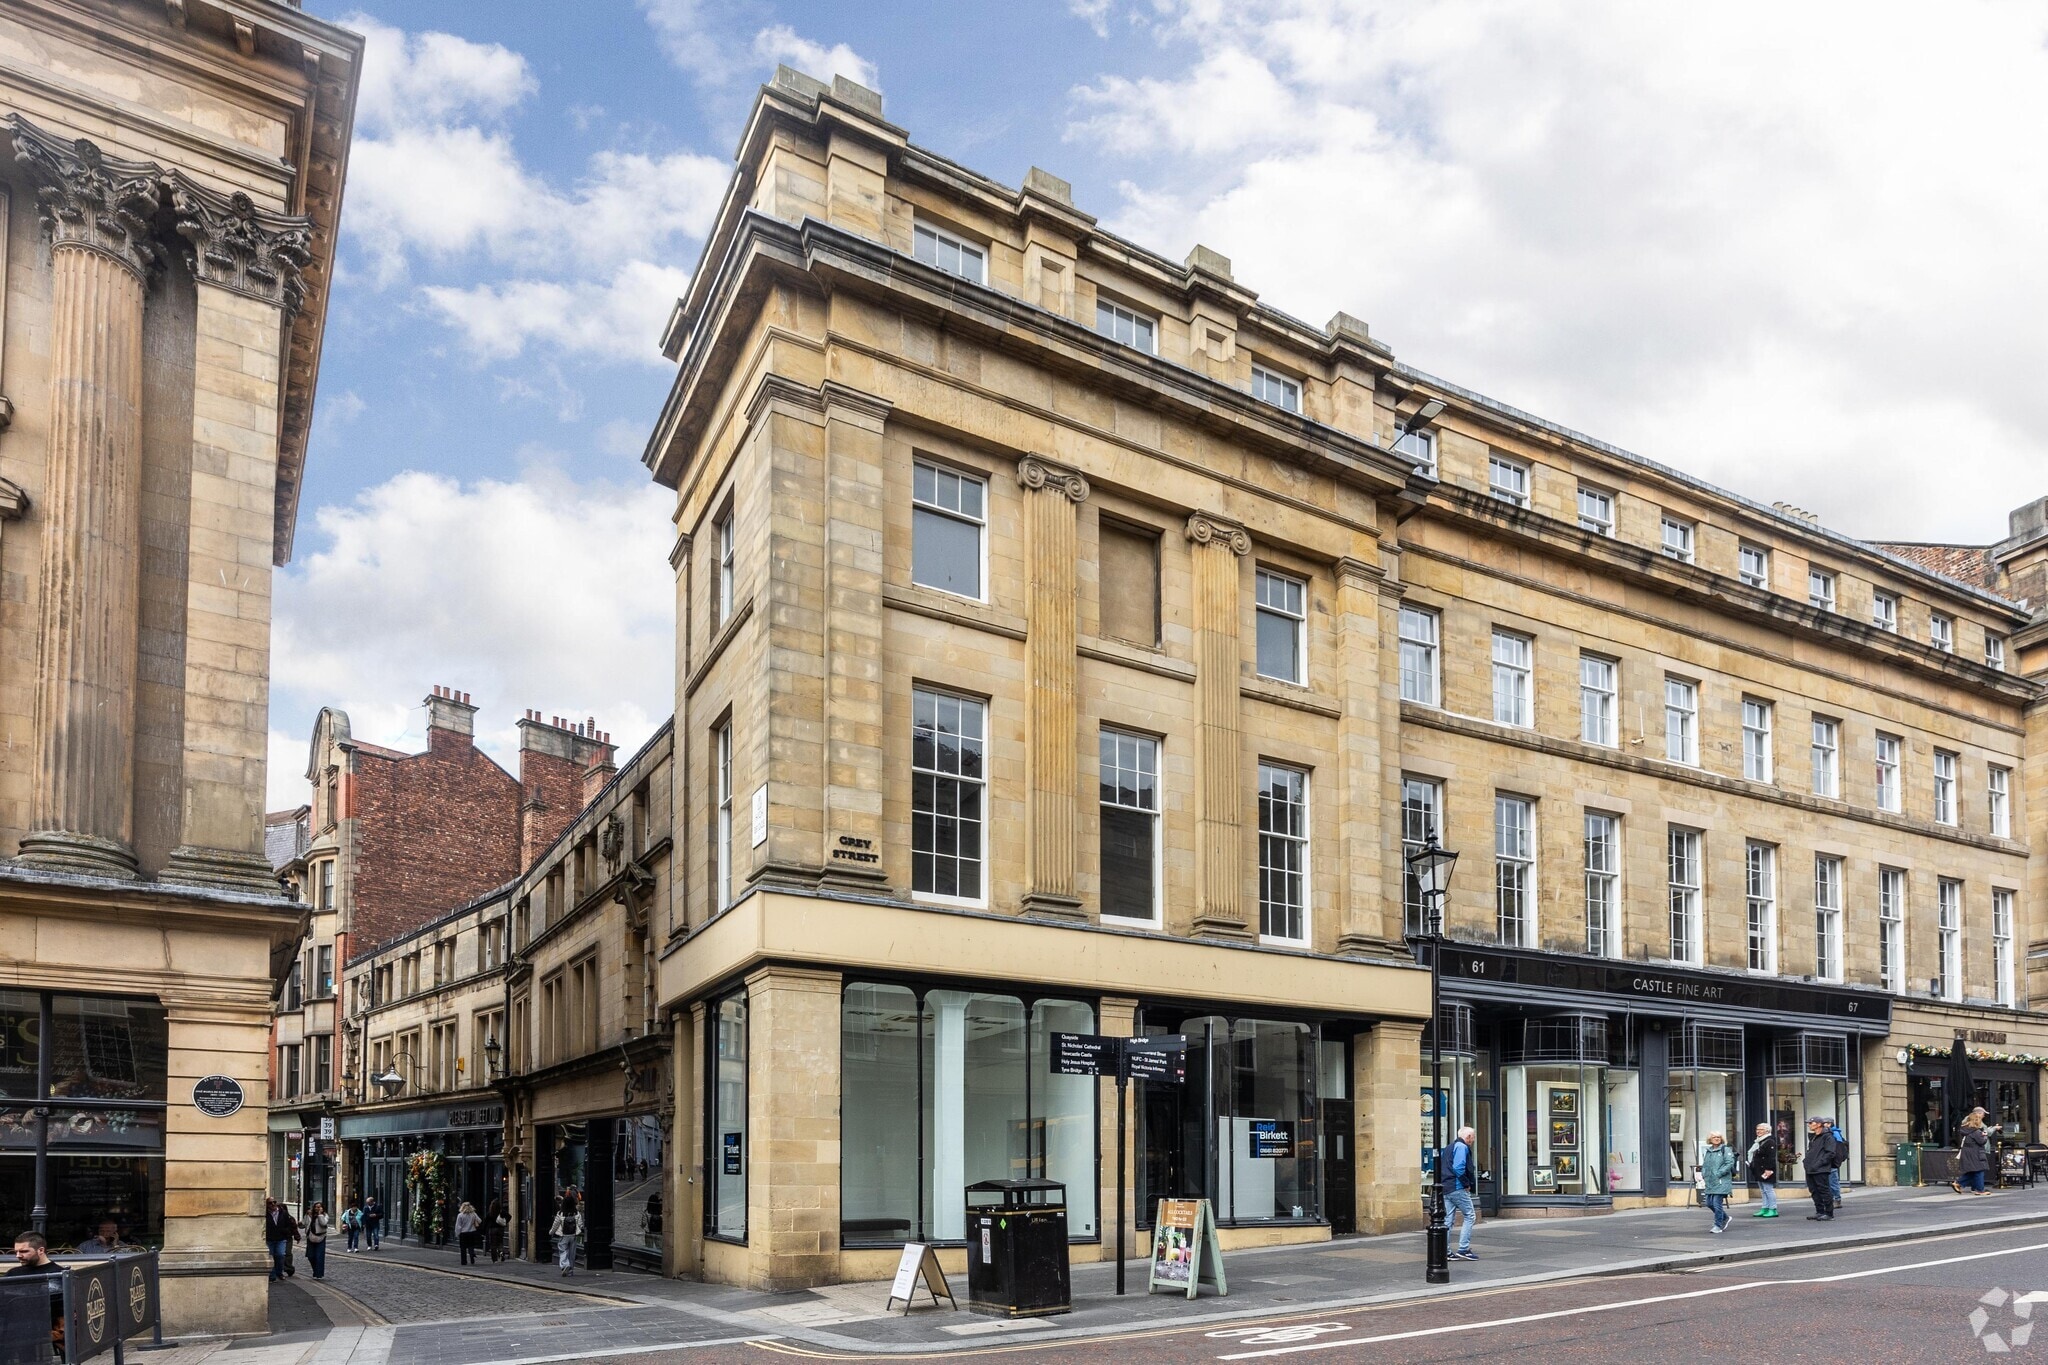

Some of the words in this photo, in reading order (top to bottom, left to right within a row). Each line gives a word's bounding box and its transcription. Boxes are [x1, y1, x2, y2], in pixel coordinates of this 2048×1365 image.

[839, 836, 871, 849] GREY
[833, 849, 879, 863] STREET
[1472, 960, 1484, 973] 61
[1633, 978, 1673, 993] CASTLE
[1676, 983, 1700, 997] FINE
[1702, 986, 1724, 999] ART
[1848, 1001, 1858, 1012] 67
[1256, 1122, 1276, 1131] Reid
[1260, 1131, 1288, 1140] Birkett
